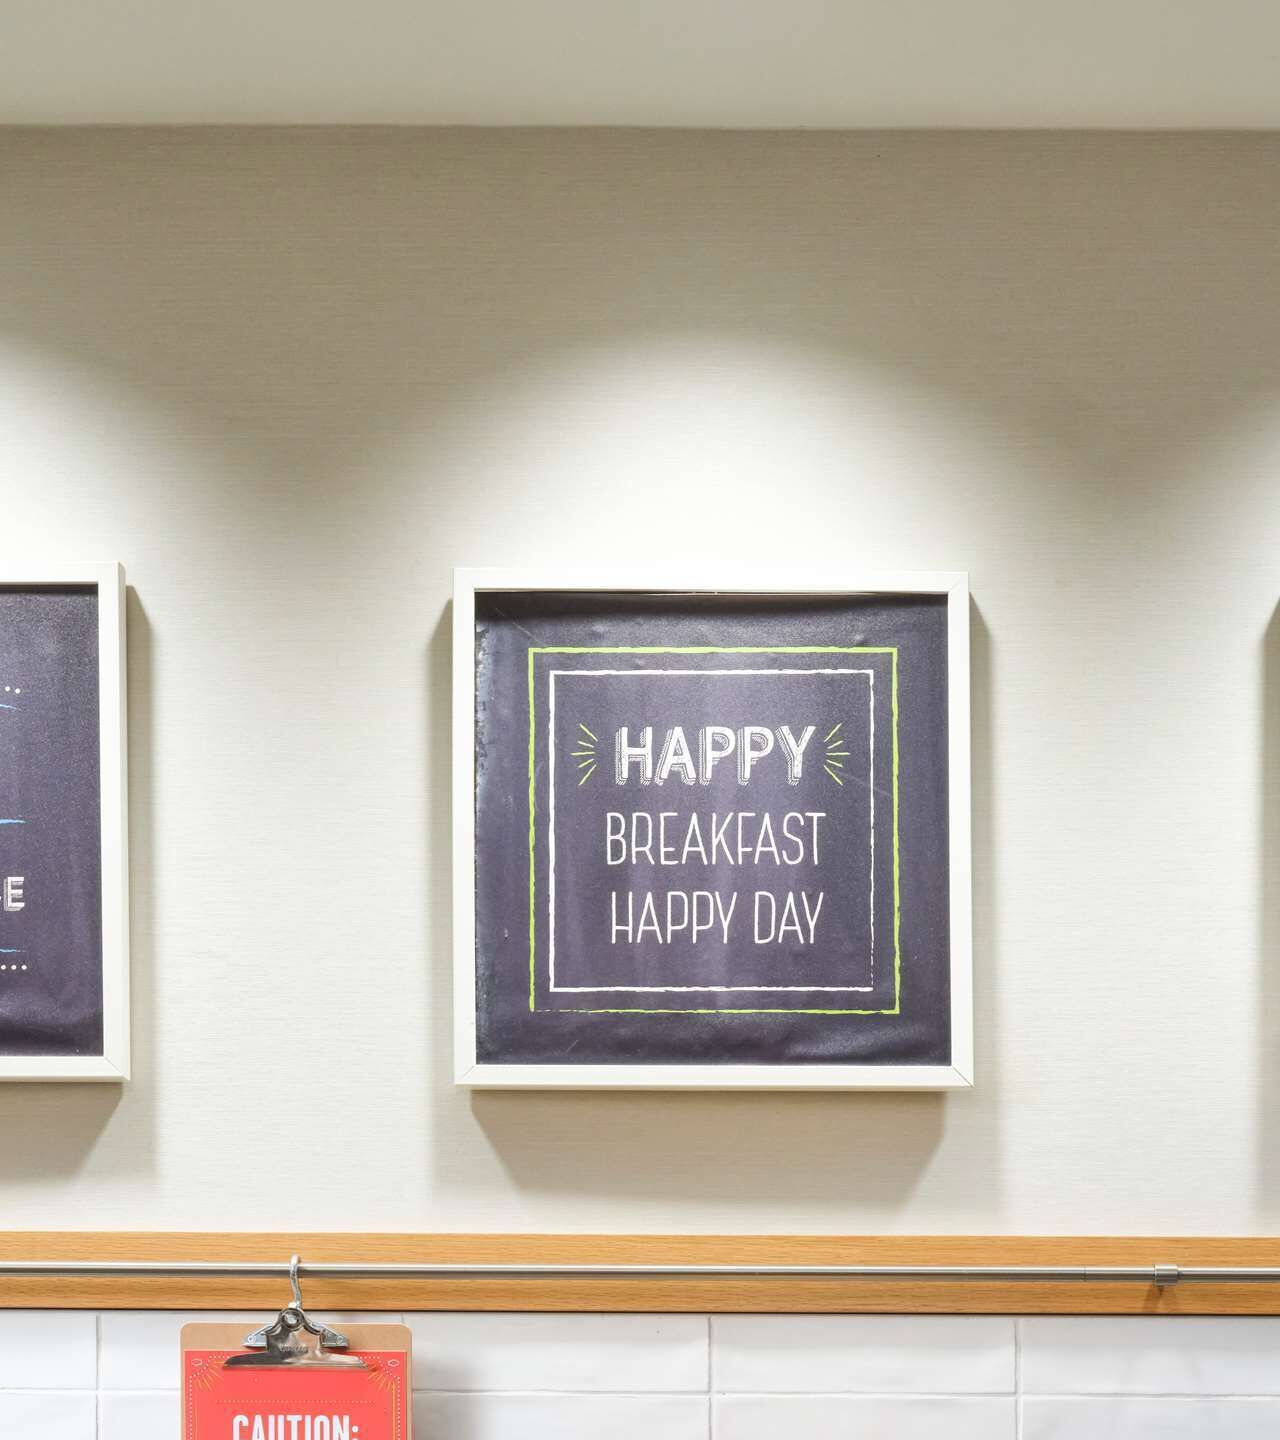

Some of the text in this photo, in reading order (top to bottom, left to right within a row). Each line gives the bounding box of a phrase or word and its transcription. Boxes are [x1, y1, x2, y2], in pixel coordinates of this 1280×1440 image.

[615, 725, 817, 786] HAPPY
[606, 811, 826, 866] BREAKFAST
[611, 890, 824, 945] HAPPY DAY
